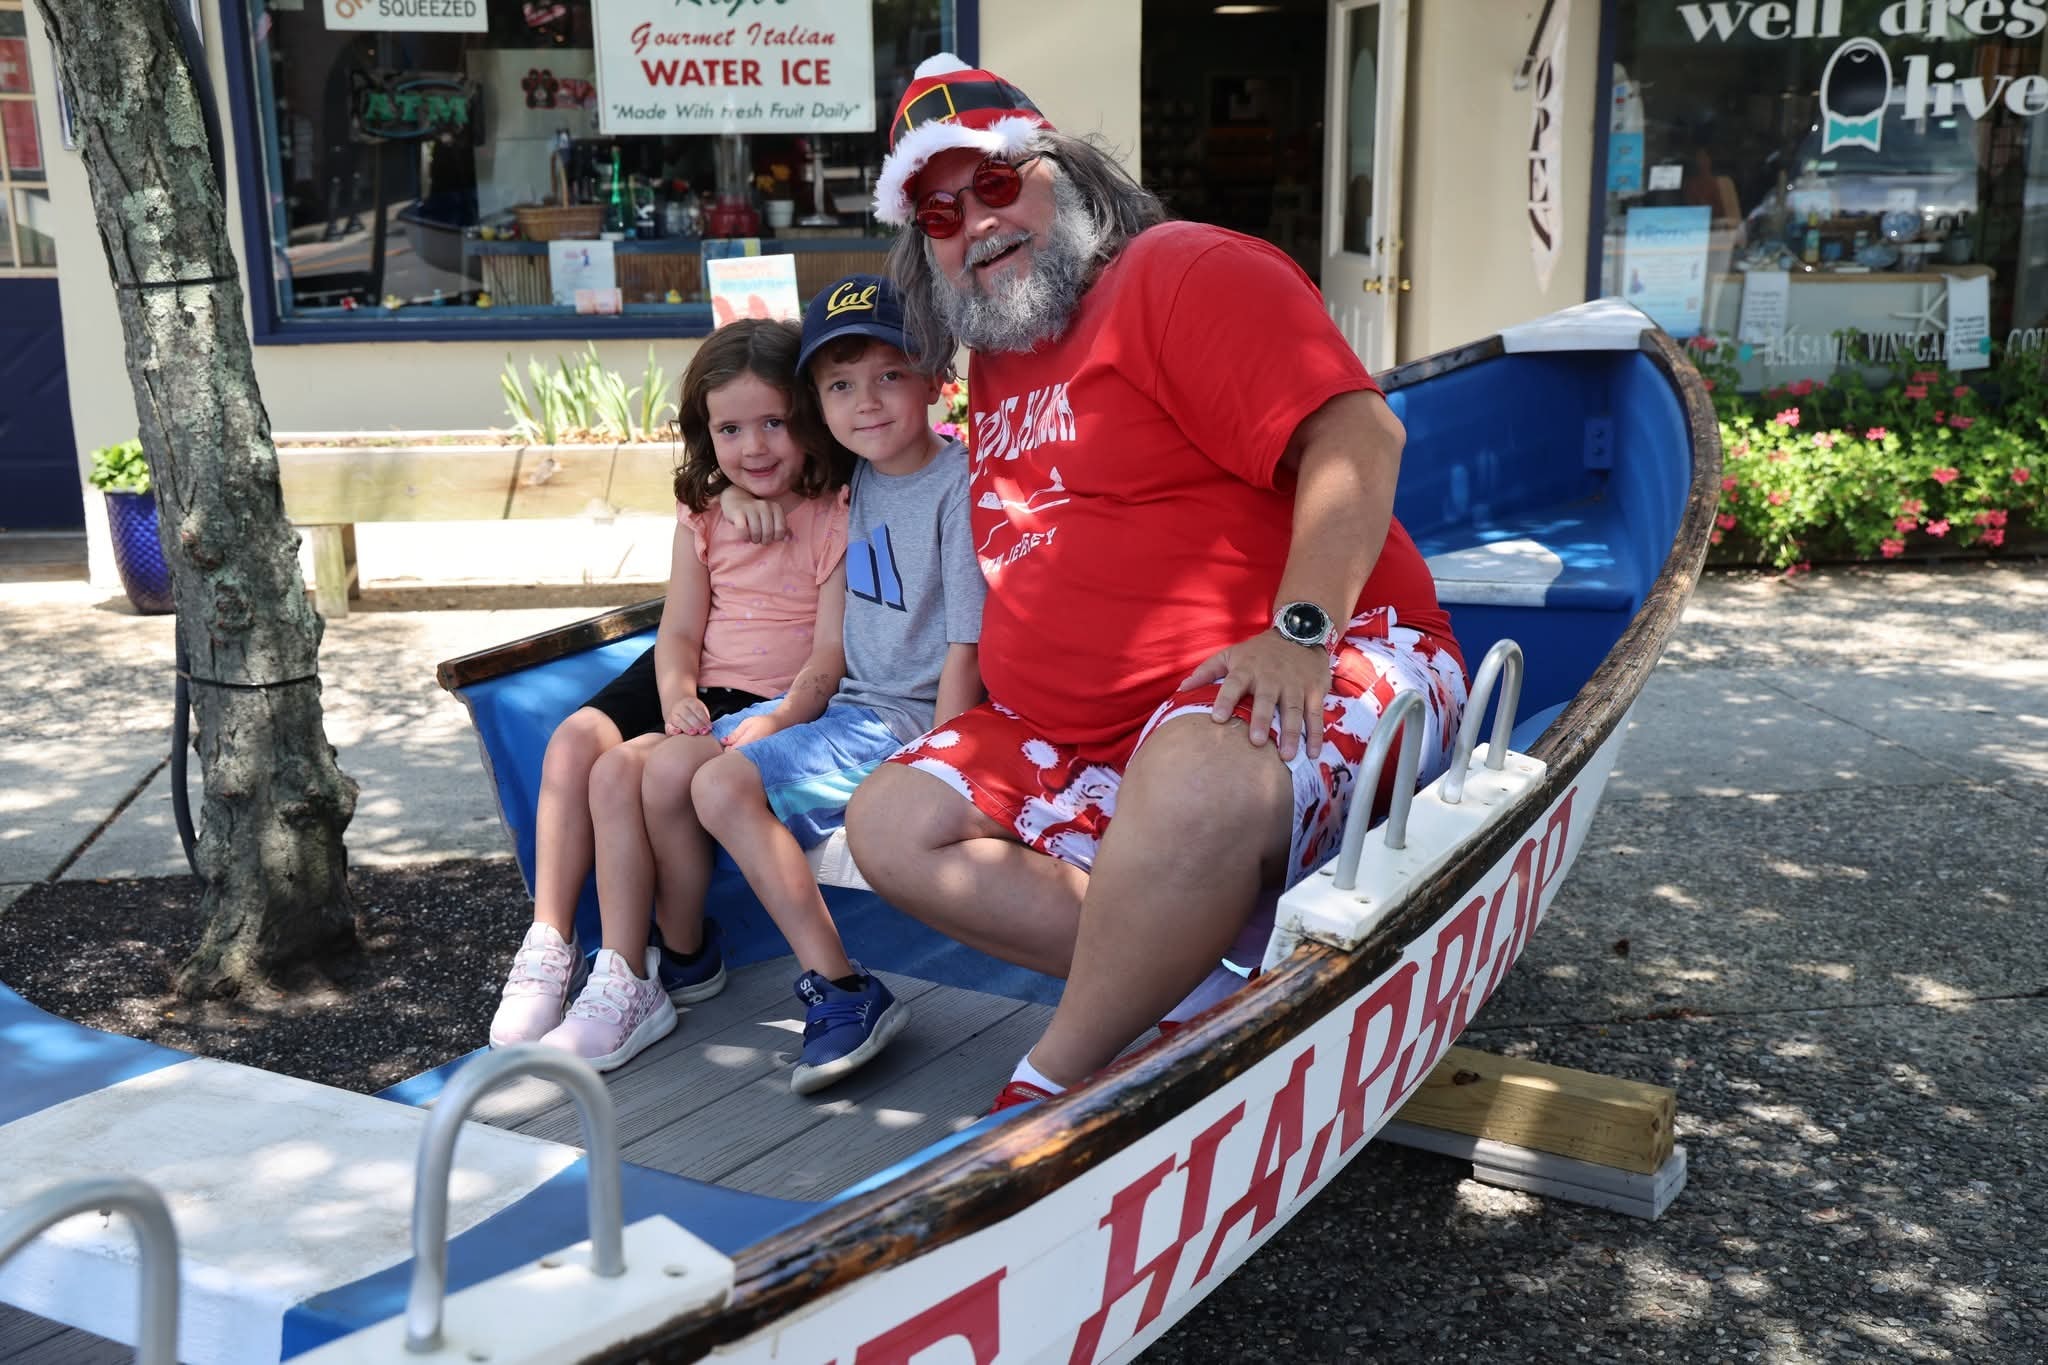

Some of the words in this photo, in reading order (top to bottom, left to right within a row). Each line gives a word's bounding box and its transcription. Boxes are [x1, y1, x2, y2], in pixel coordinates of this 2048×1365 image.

[379, 0, 477, 17] SQUEEZED
[1676, 0, 1842, 42] well
[631, 22, 736, 54] Gourmet
[746, 22, 836, 46] Italian
[641, 59, 762, 86] WATER
[782, 59, 831, 85] ICE
[366, 92, 469, 123] ATM
[676, 103, 714, 118] With
[720, 104, 763, 118] Fesh
[769, 103, 804, 118] Fruit
[1528, 56, 1554, 251] OPEN
[826, 282, 877, 320] Cal
[1067, 785, 1579, 1365] HARBOR
